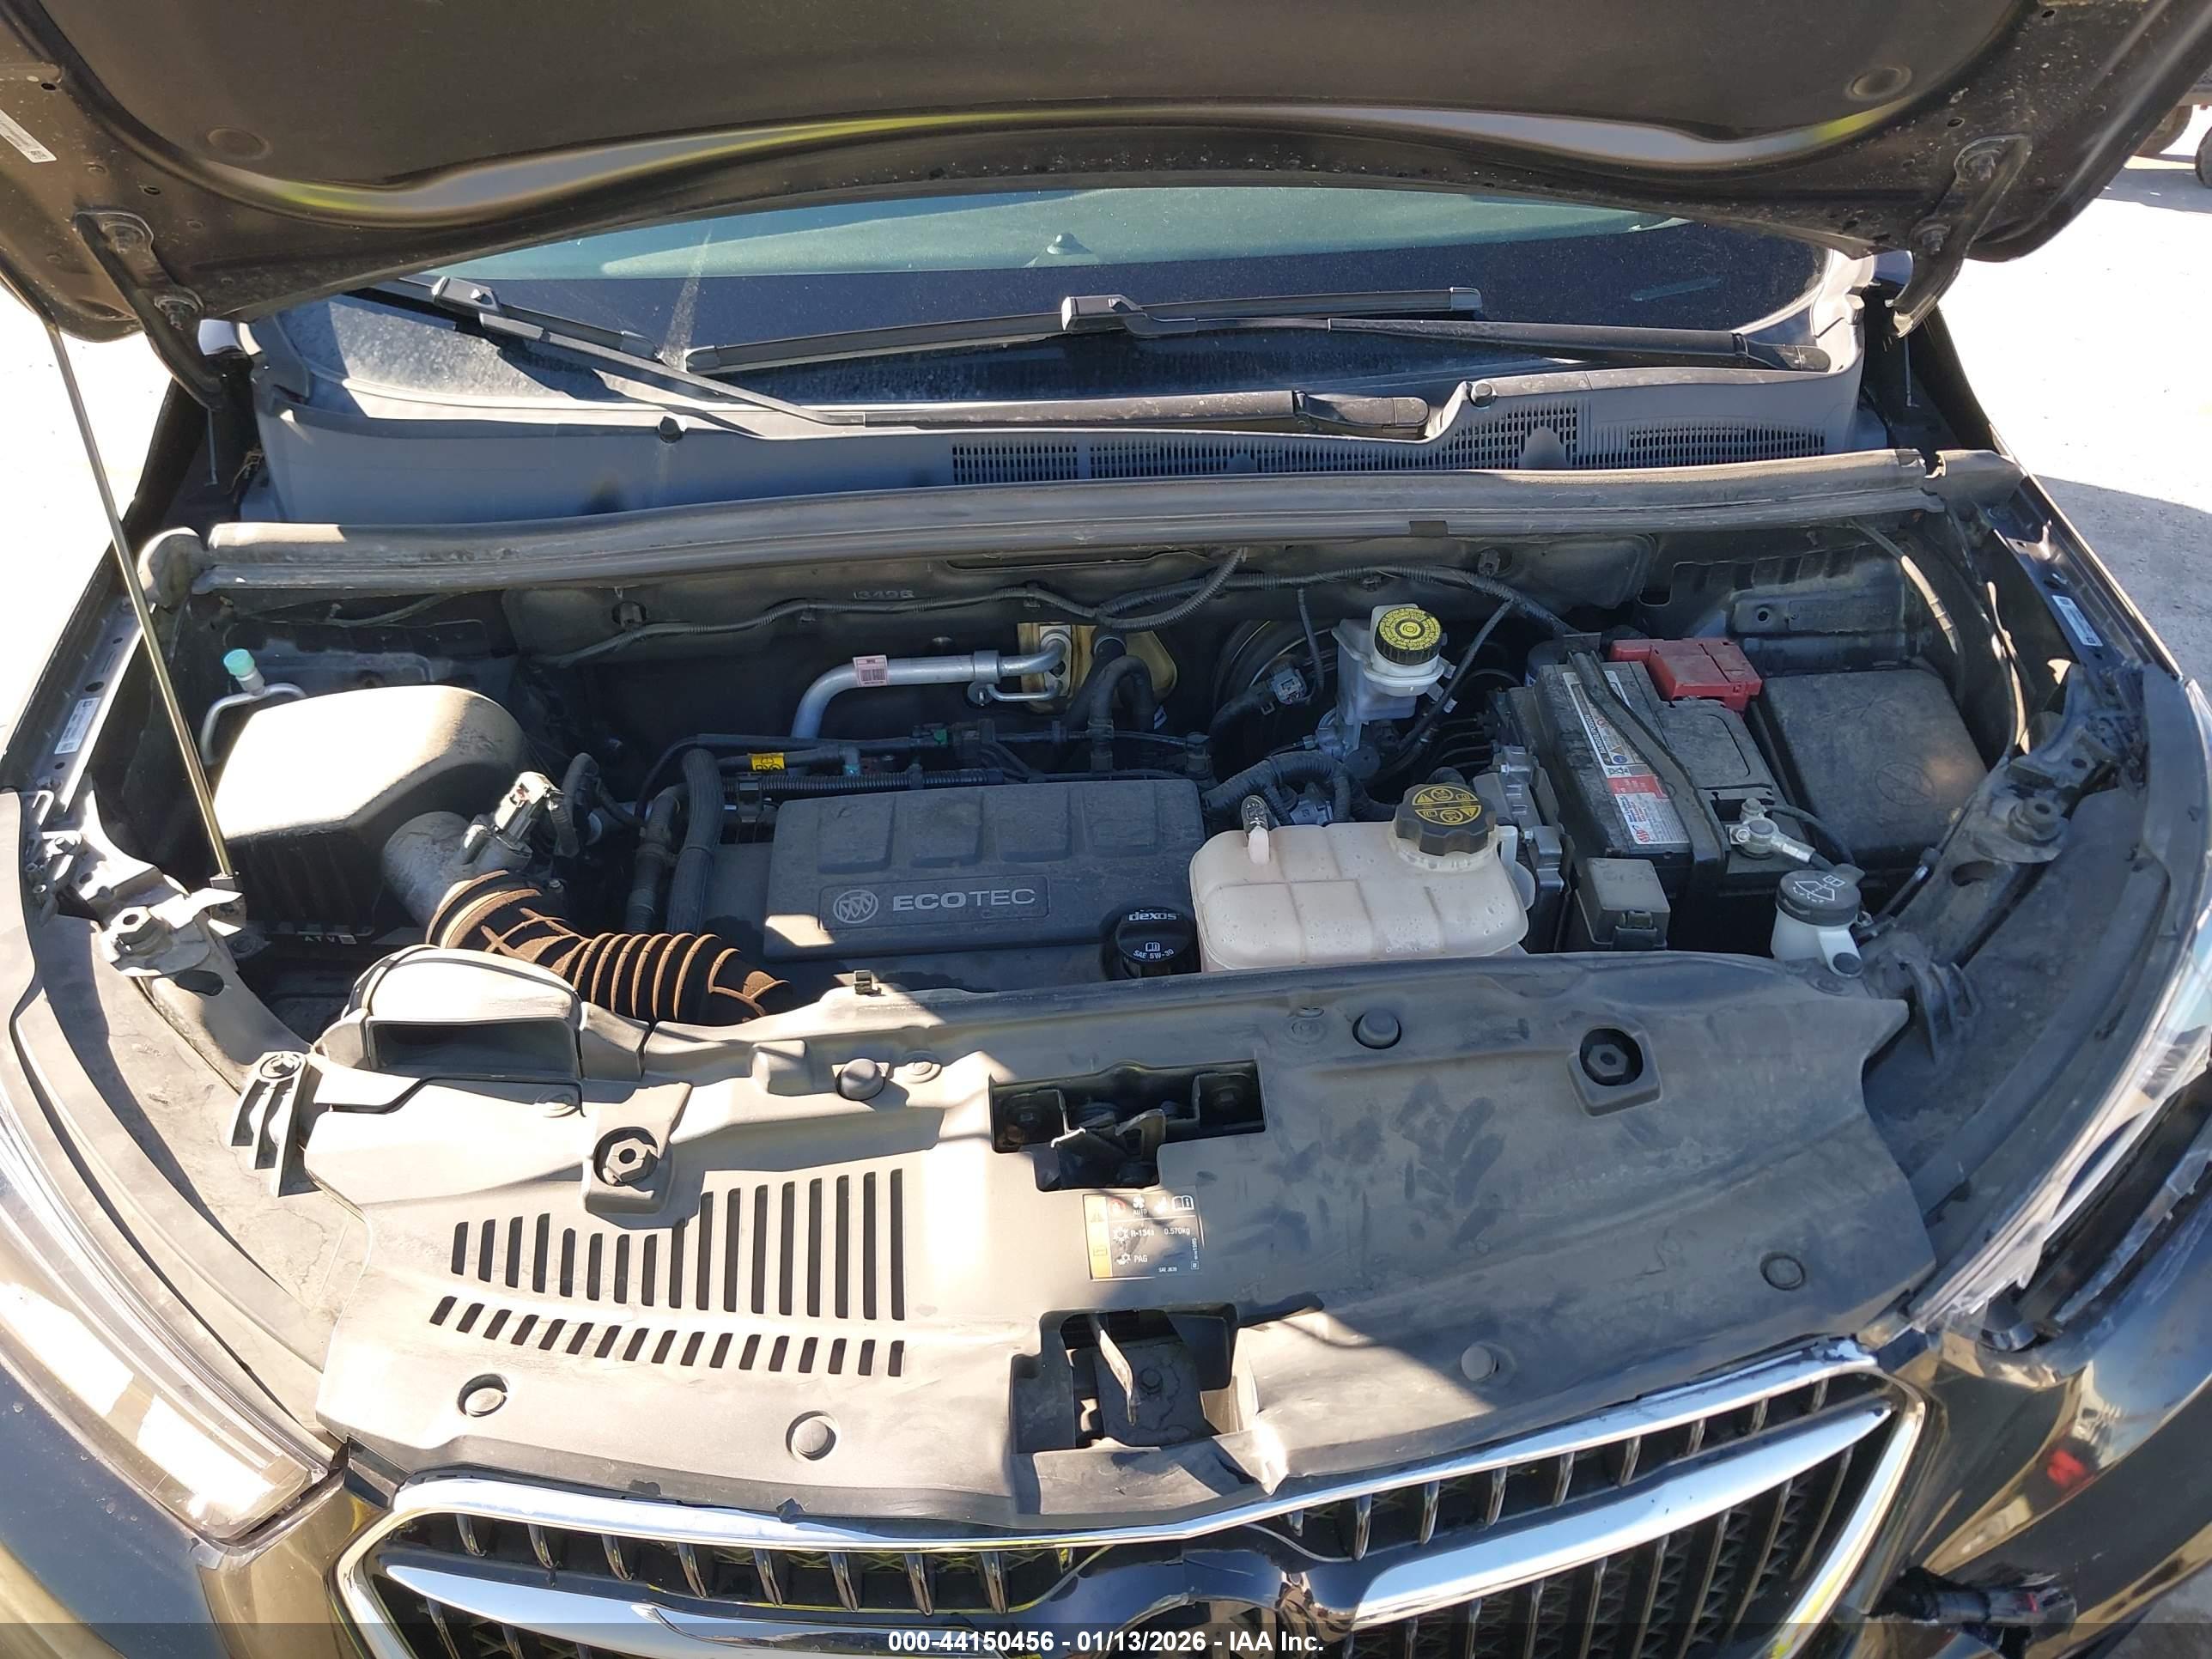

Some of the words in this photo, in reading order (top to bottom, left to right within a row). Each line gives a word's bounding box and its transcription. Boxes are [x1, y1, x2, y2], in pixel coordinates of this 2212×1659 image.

[892, 888, 1036, 912] ECOTEC
[1128, 911, 1177, 921] dexos
[1133, 950, 1147, 959] SAE
[1149, 949, 1175, 959] 5W-30
[1164, 1227, 1191, 1236] 0.570kg
[1133, 1255, 1148, 1263] PAG
